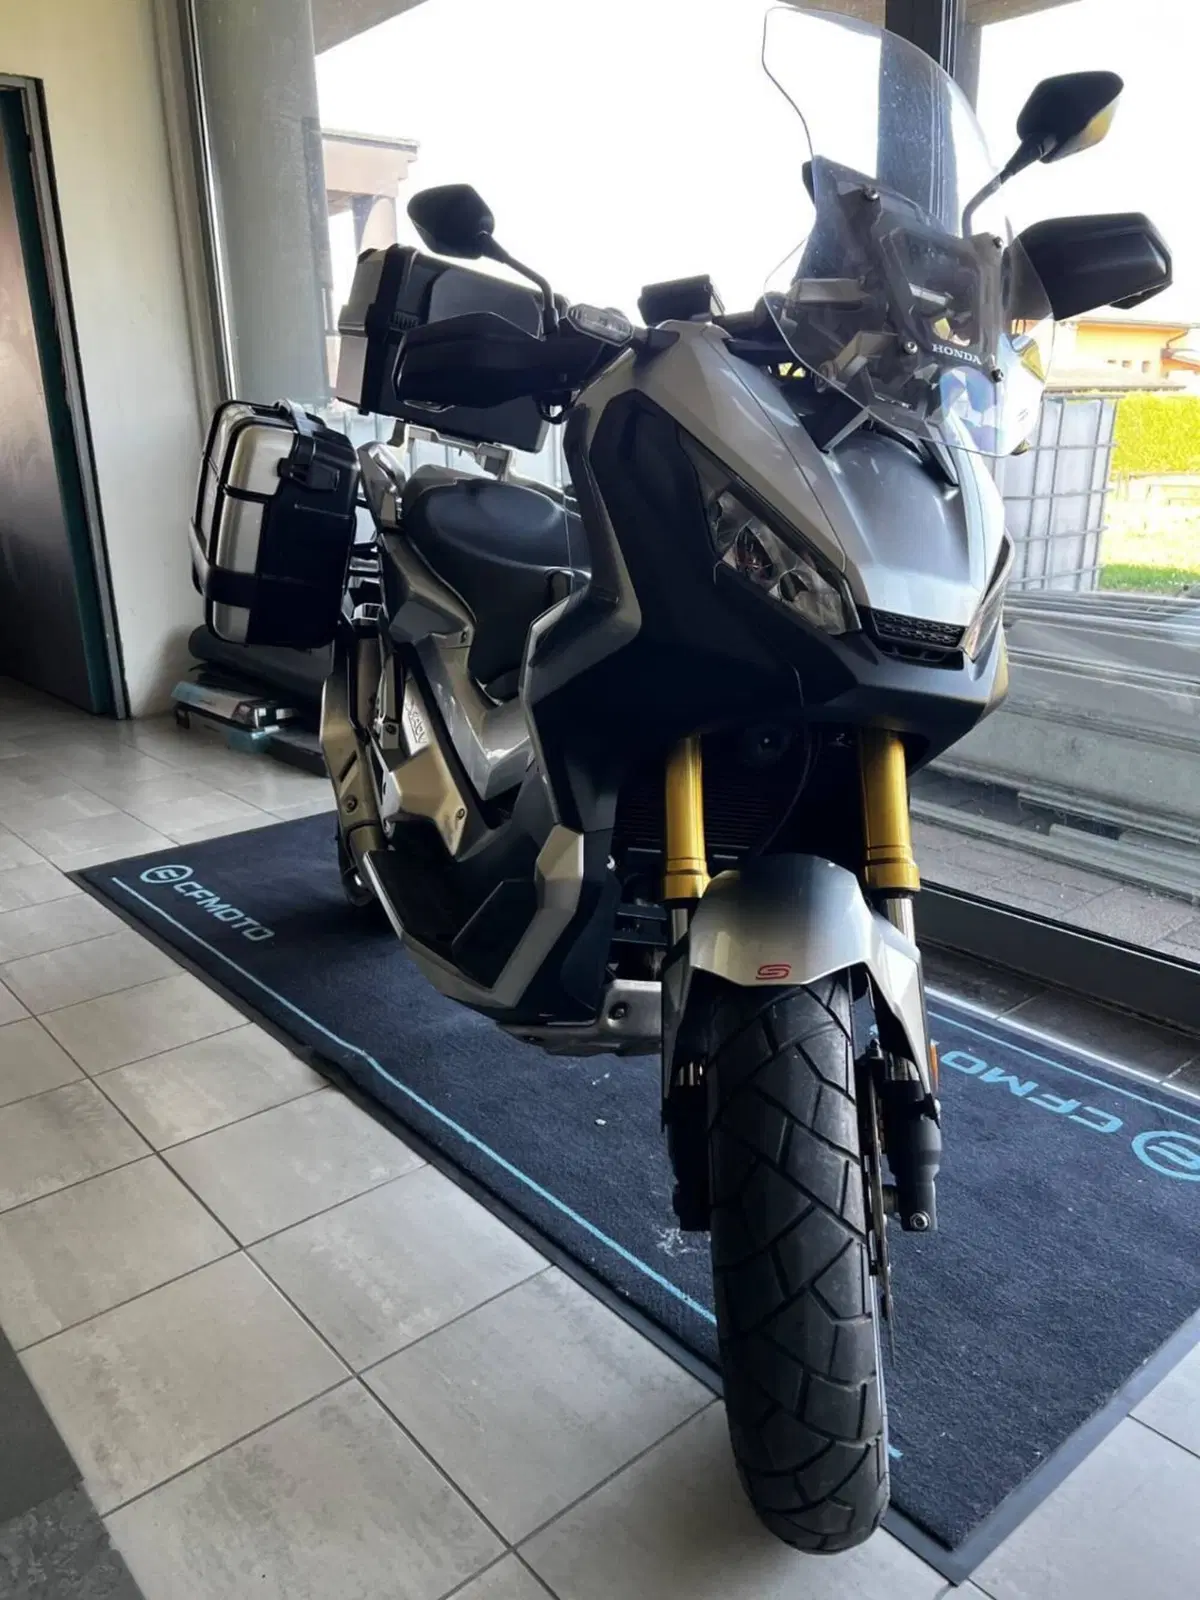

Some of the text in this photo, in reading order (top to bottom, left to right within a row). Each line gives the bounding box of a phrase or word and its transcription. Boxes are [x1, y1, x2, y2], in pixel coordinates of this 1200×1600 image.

[932, 344, 982, 365] HONDA
[173, 881, 275, 941] CFMOTO
[932, 1042, 1123, 1133] CFMO
